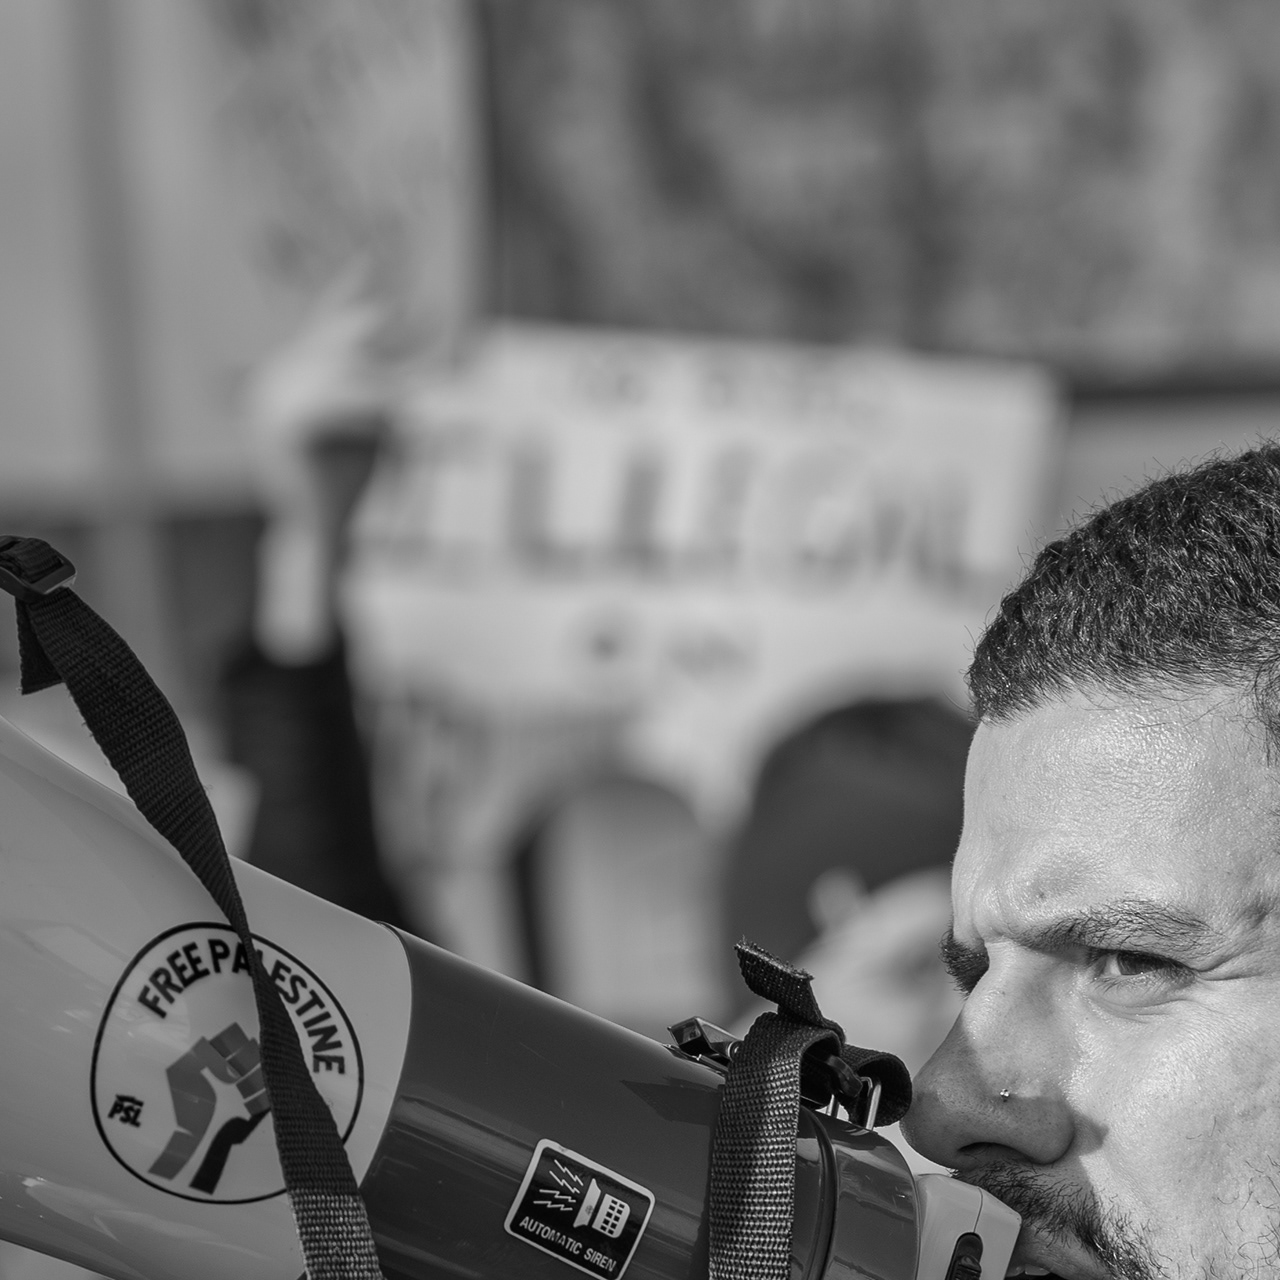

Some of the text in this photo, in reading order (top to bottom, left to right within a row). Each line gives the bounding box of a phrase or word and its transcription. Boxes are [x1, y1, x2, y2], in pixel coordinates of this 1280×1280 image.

[137, 938, 346, 1076] FREE PAESTINE
[107, 1095, 144, 1128] PSL
[518, 1216, 617, 1273] AUTOMATIC SIREN
